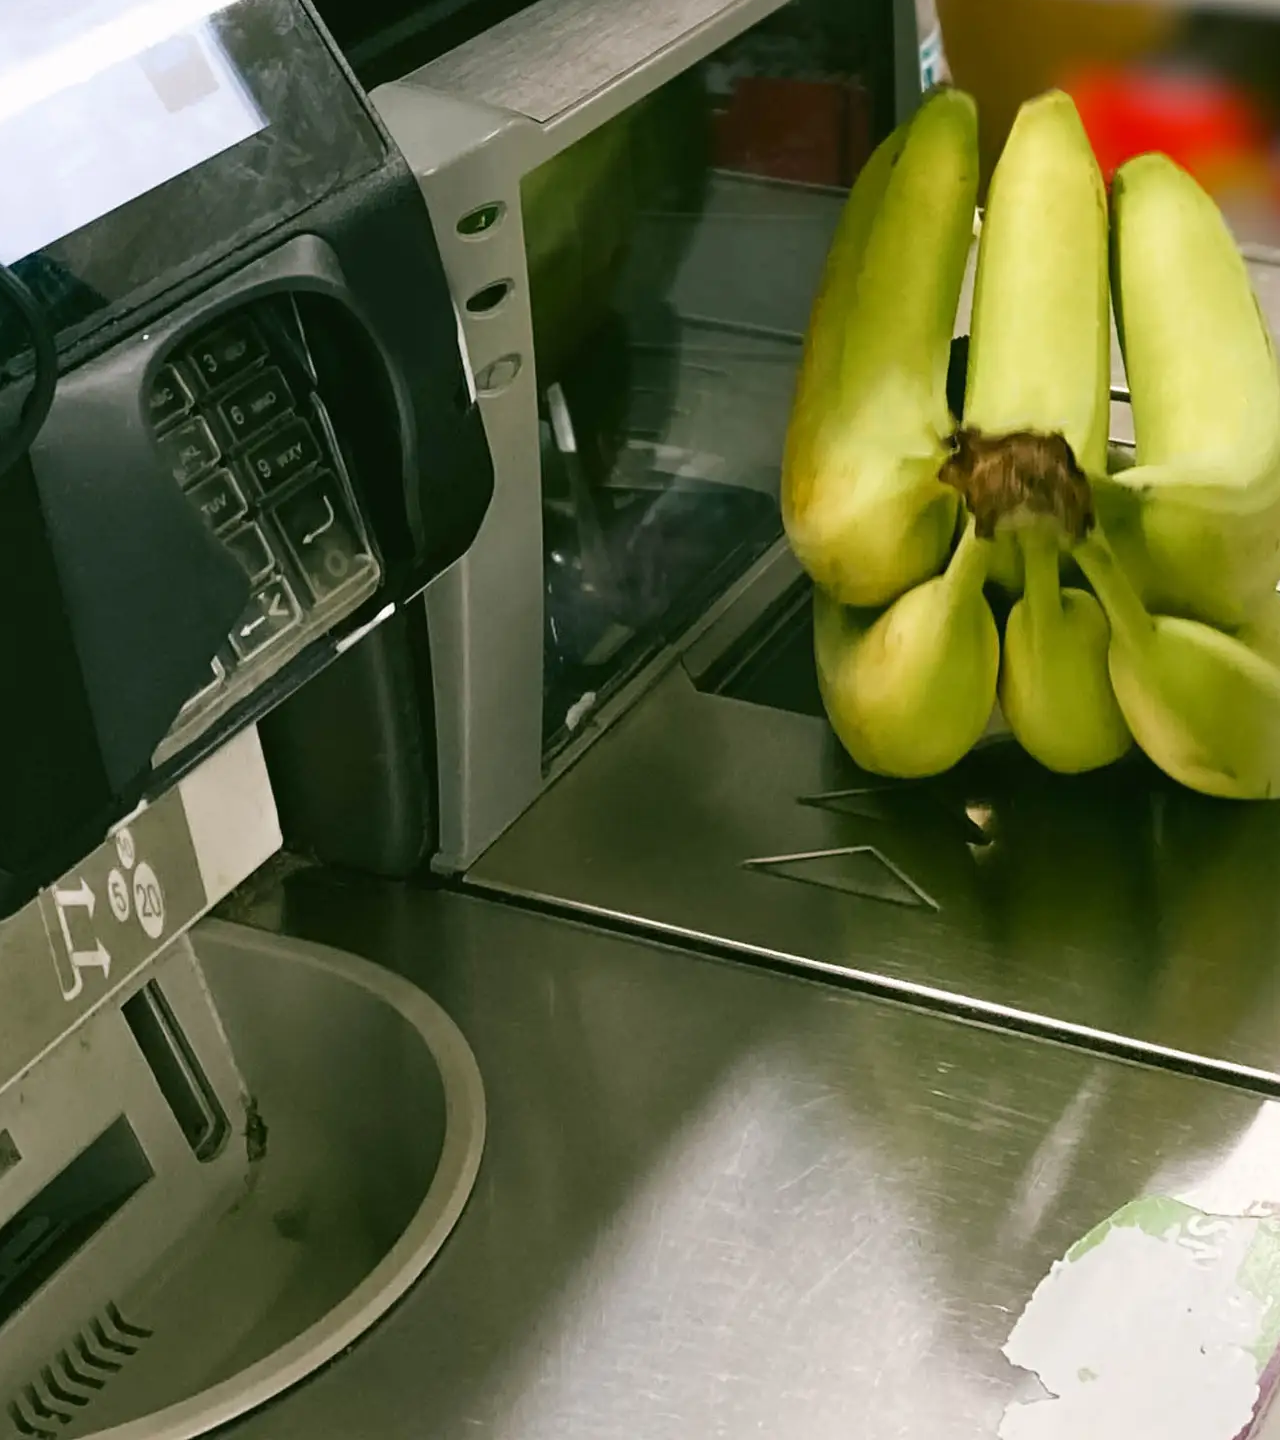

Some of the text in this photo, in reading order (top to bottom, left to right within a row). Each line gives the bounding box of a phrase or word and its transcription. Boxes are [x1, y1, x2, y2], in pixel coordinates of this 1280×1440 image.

[202, 353, 218, 372] 3
[230, 405, 245, 425] 6
[257, 458, 272, 479] 9
[111, 882, 127, 913] 5
[135, 883, 162, 917] 20
